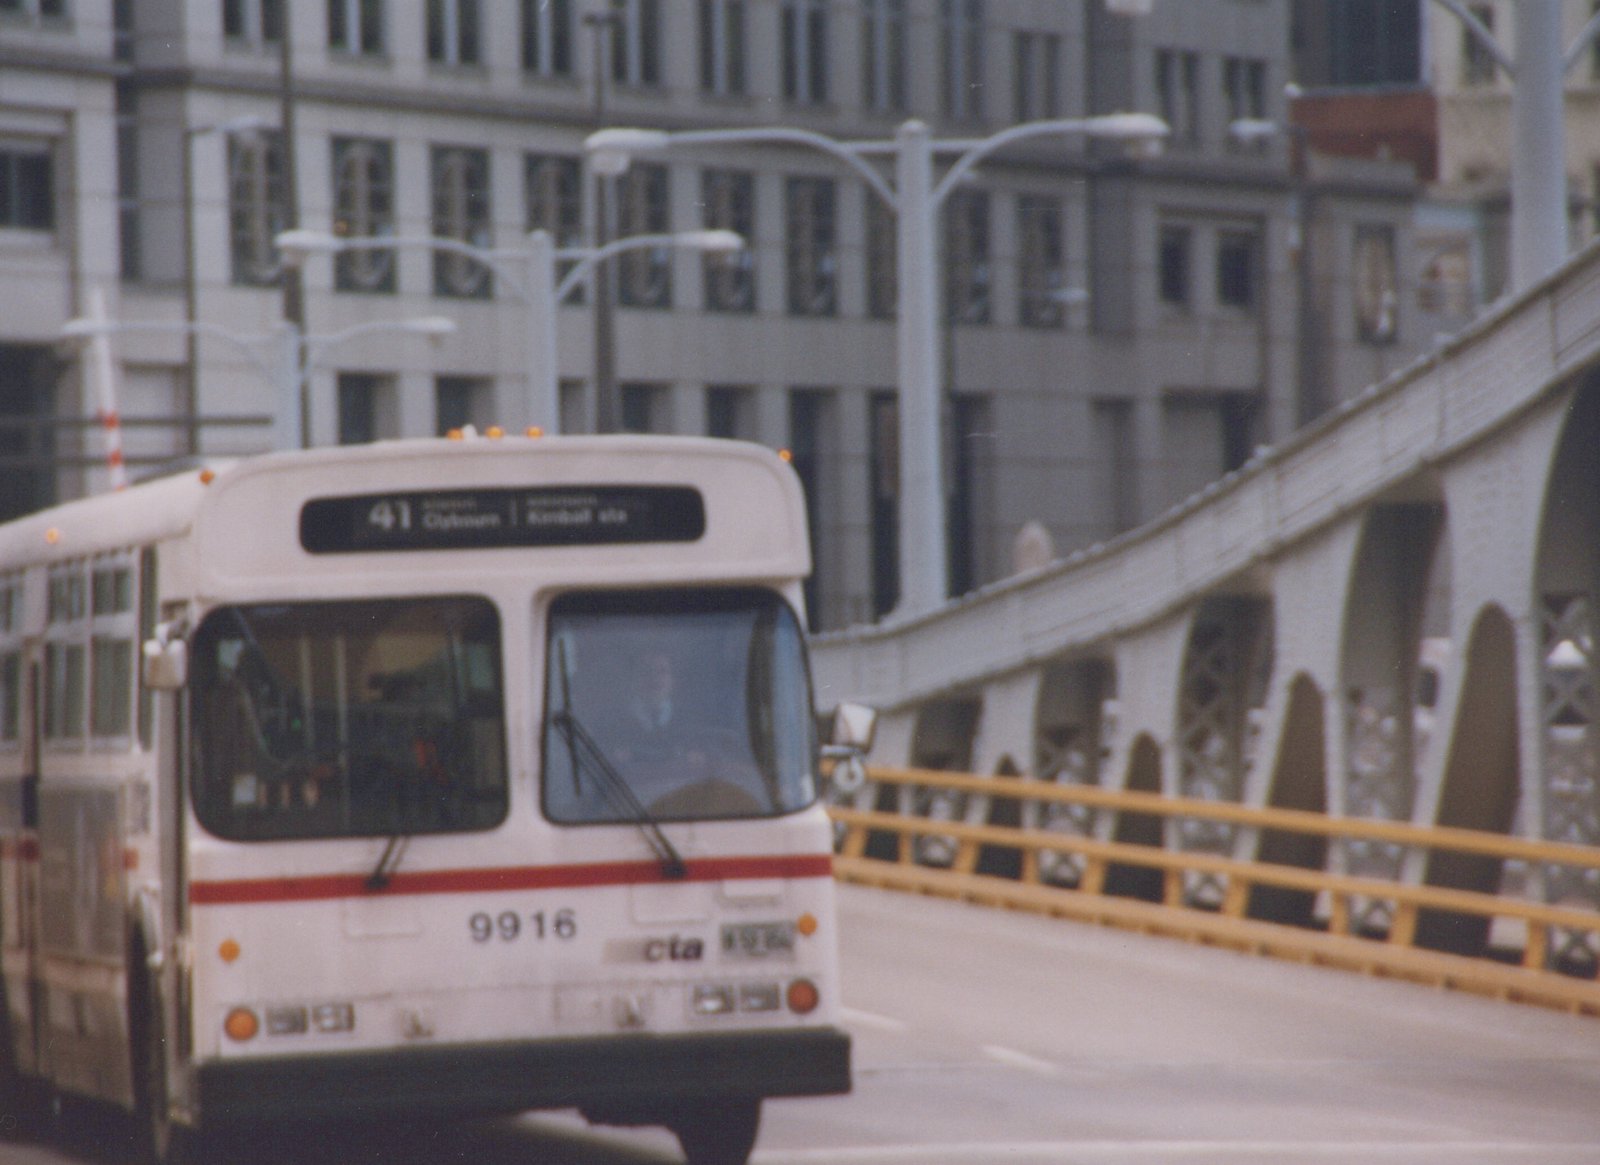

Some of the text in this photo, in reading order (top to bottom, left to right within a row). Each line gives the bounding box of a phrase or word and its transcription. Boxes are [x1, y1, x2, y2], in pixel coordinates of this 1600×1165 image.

[369, 500, 411, 530] 41
[469, 909, 578, 943] 9916
[645, 934, 705, 962] cta
